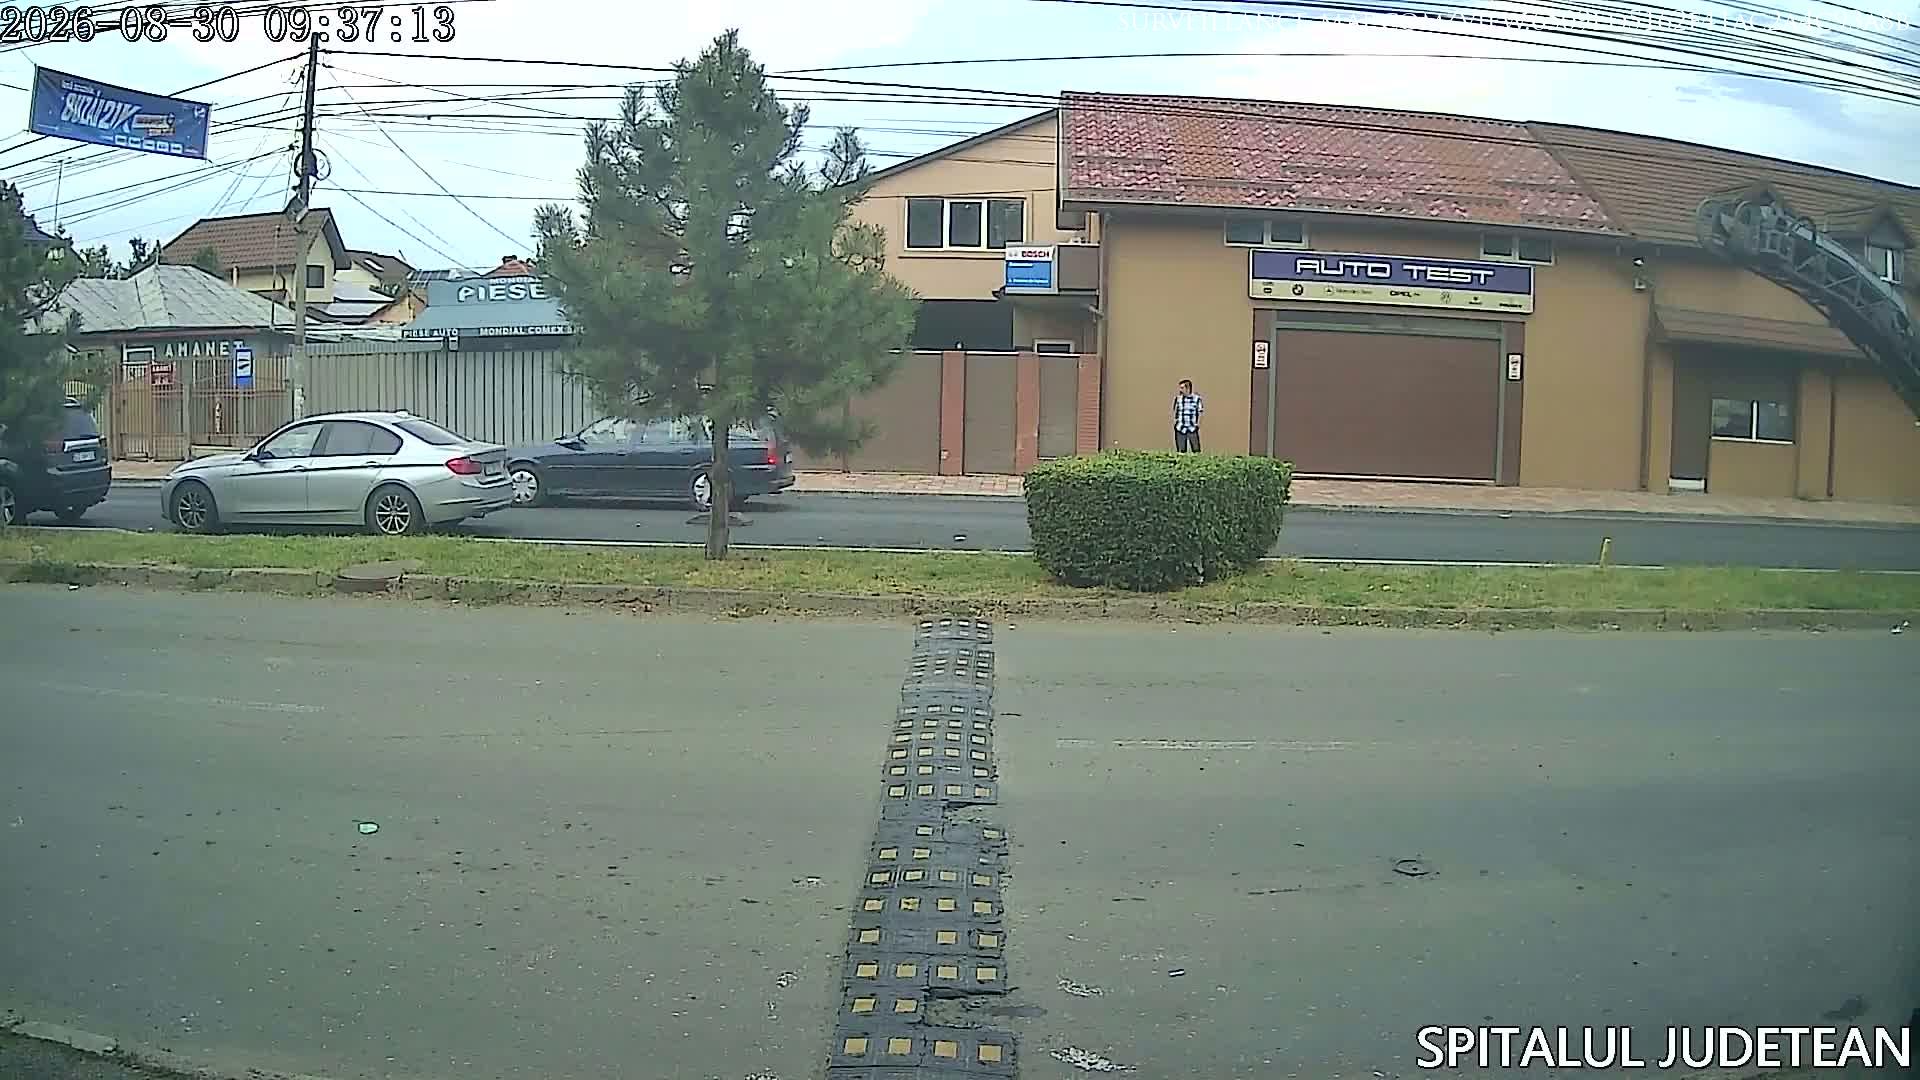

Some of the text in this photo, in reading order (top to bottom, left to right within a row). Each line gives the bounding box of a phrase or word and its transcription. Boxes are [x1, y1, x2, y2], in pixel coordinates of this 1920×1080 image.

[1021, 250, 1050, 258] BOSCH
[1296, 260, 1494, 285] AUTO TEST
[457, 283, 546, 302] PIESE
[431, 328, 458, 337] AUTO
[479, 327, 526, 336] MONDIAL
